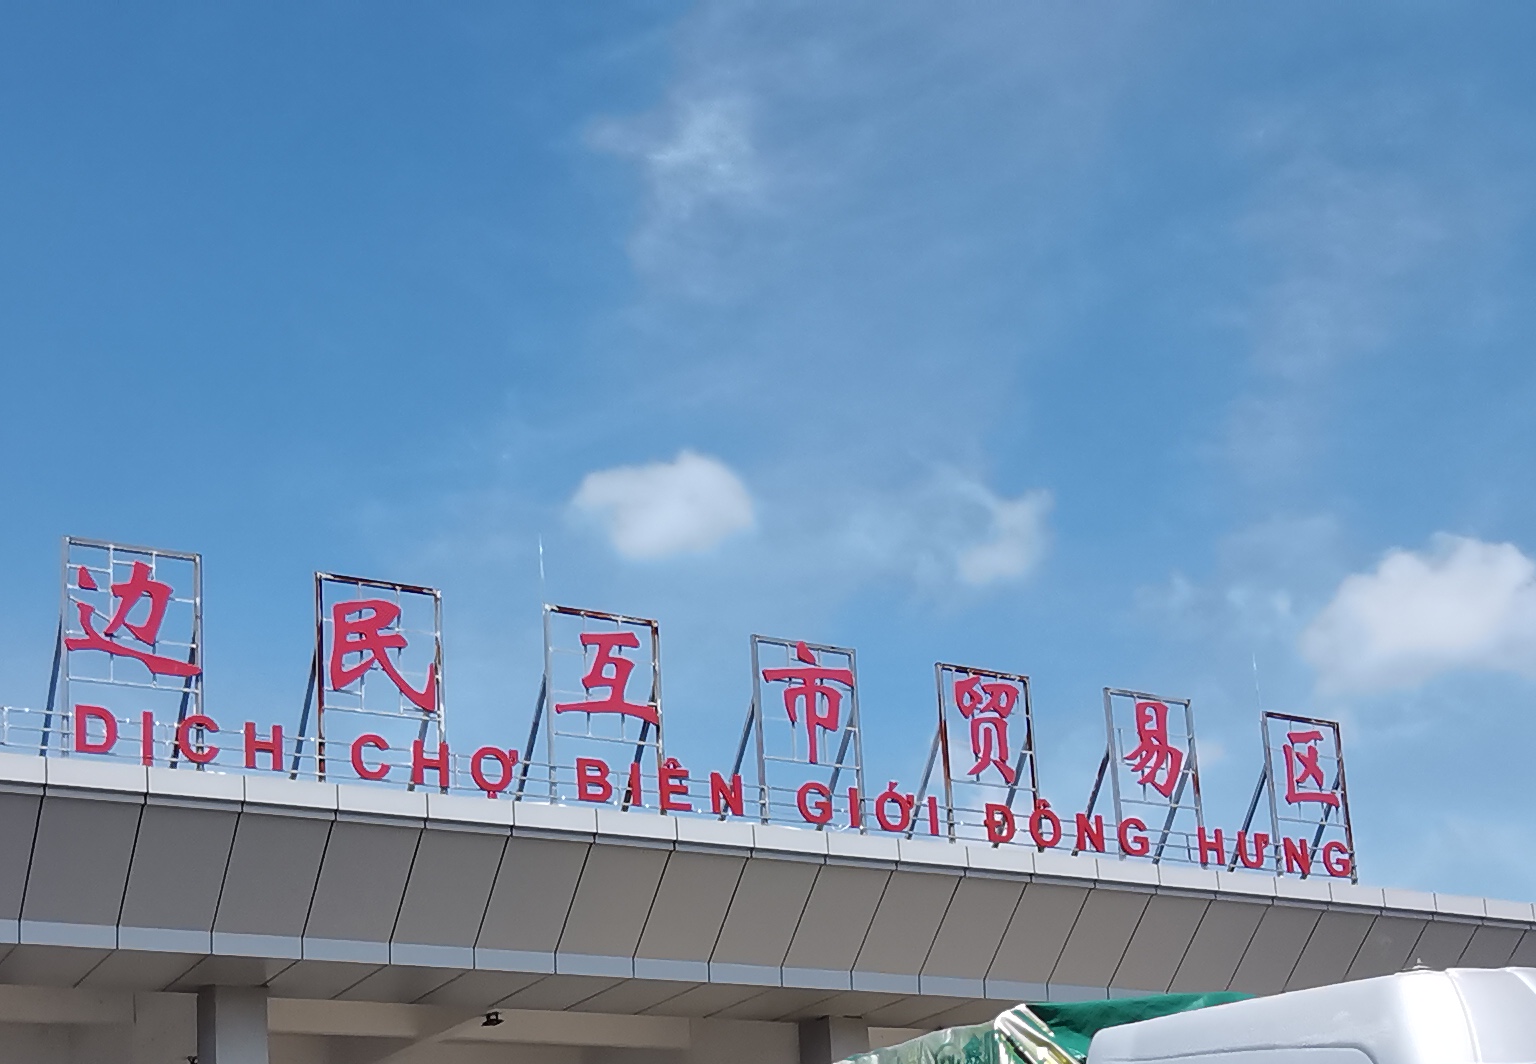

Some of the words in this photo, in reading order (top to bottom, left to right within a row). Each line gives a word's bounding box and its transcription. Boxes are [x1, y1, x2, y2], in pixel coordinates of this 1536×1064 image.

[351, 734, 519, 799] CHỢ
[576, 757, 744, 816] BIÊN
[797, 779, 939, 836] GIỚI
[984, 799, 1150, 857] ĐÔNG
[1198, 826, 1352, 877] HƯNG
